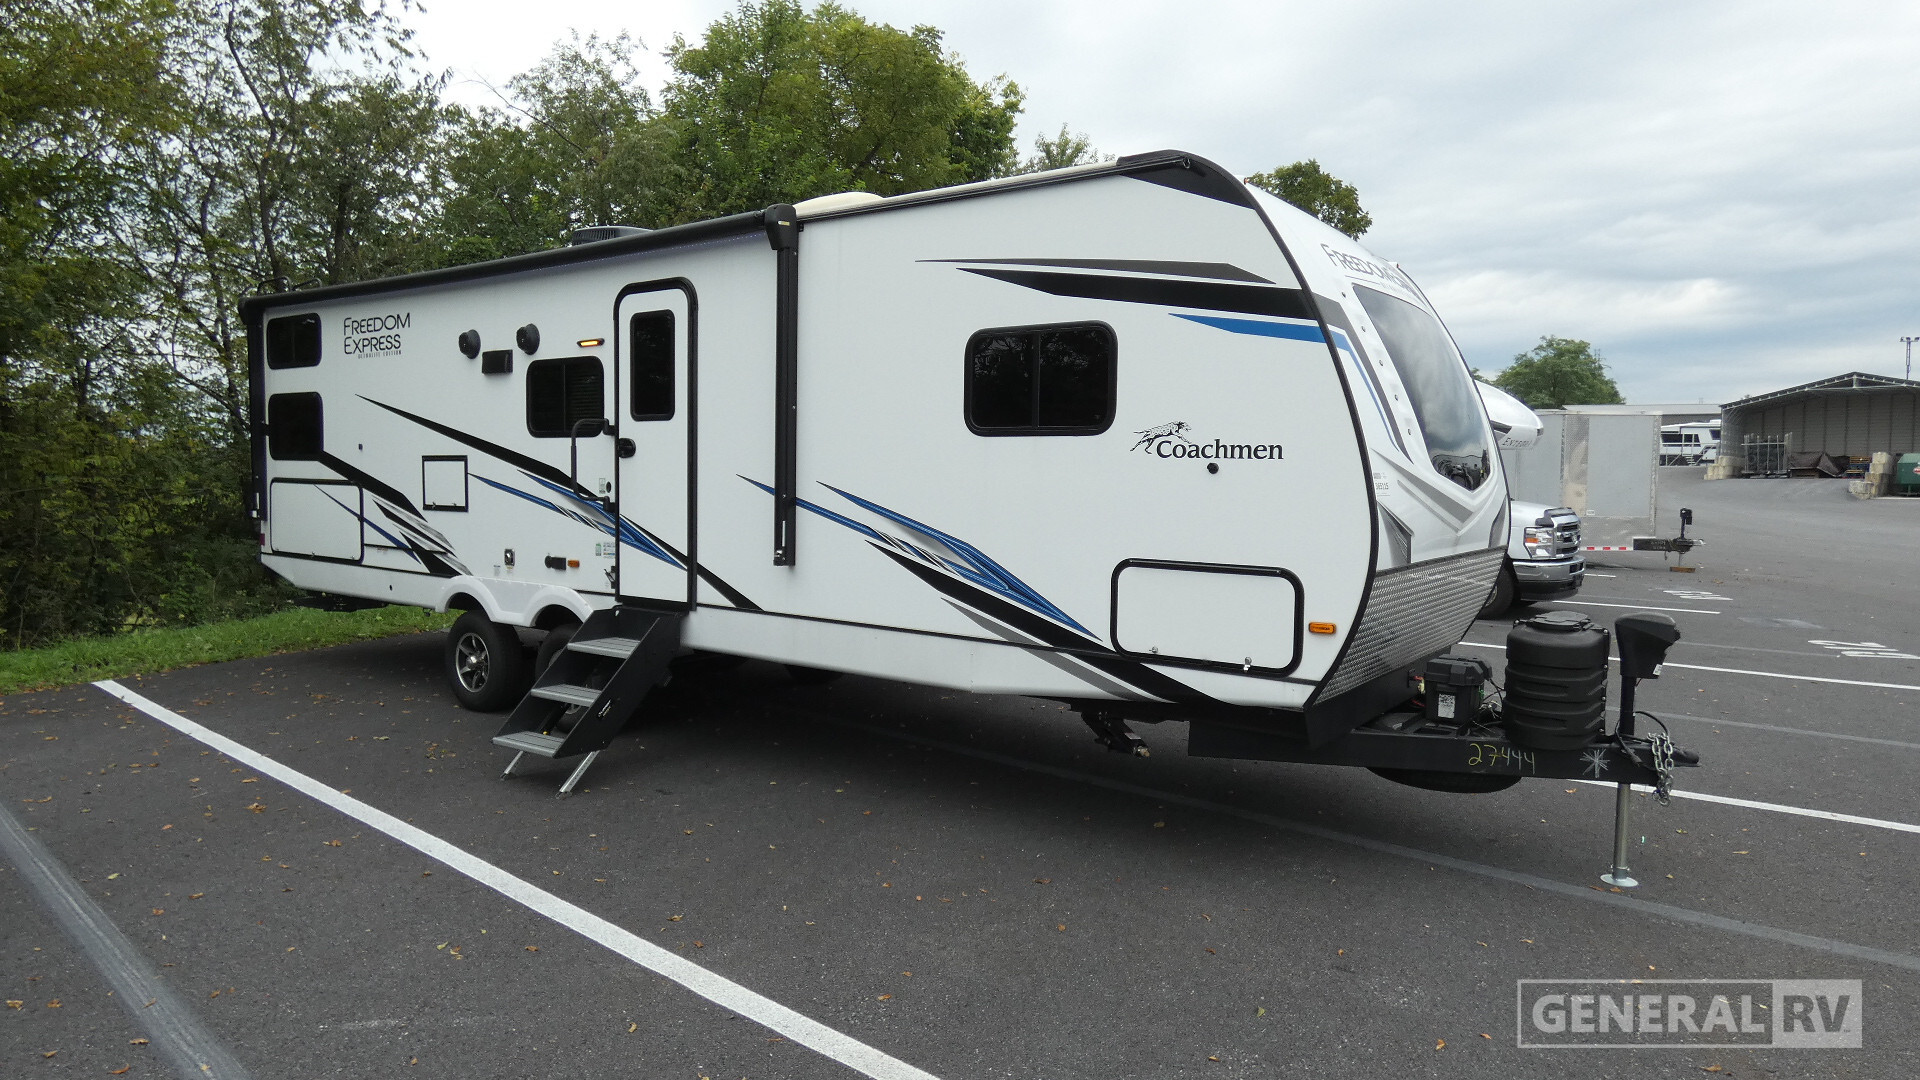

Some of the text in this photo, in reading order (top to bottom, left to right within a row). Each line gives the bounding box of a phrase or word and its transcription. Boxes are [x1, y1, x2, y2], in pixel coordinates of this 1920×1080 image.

[343, 312, 411, 336] FREEDOM
[343, 333, 402, 355] EXPRESS
[1156, 438, 1284, 460] Coachmen
[1468, 743, 1536, 775] 27444
